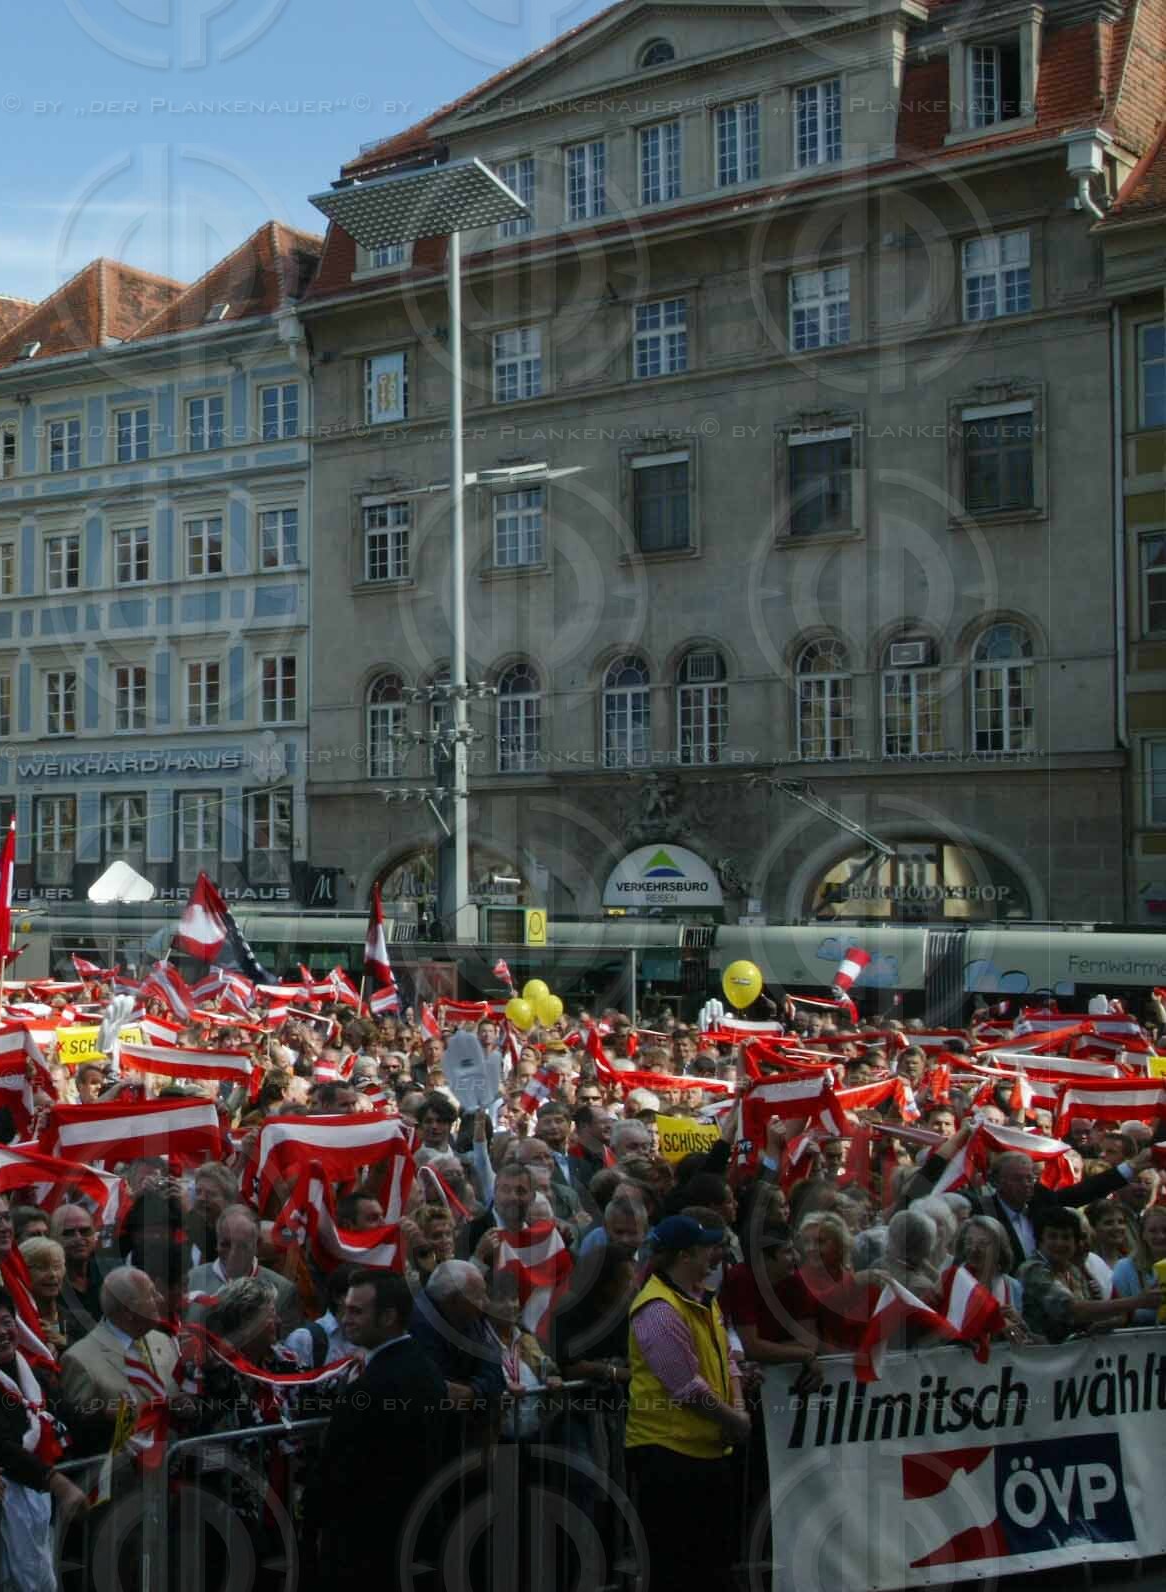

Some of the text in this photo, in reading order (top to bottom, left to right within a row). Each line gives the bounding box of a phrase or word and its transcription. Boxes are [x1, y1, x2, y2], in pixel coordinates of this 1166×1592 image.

[616, 880, 709, 892] VERKEHRSBÜRO
[788, 1366, 1030, 1449] Tillmitsch
[1002, 1455, 1118, 1529] ÖVP
